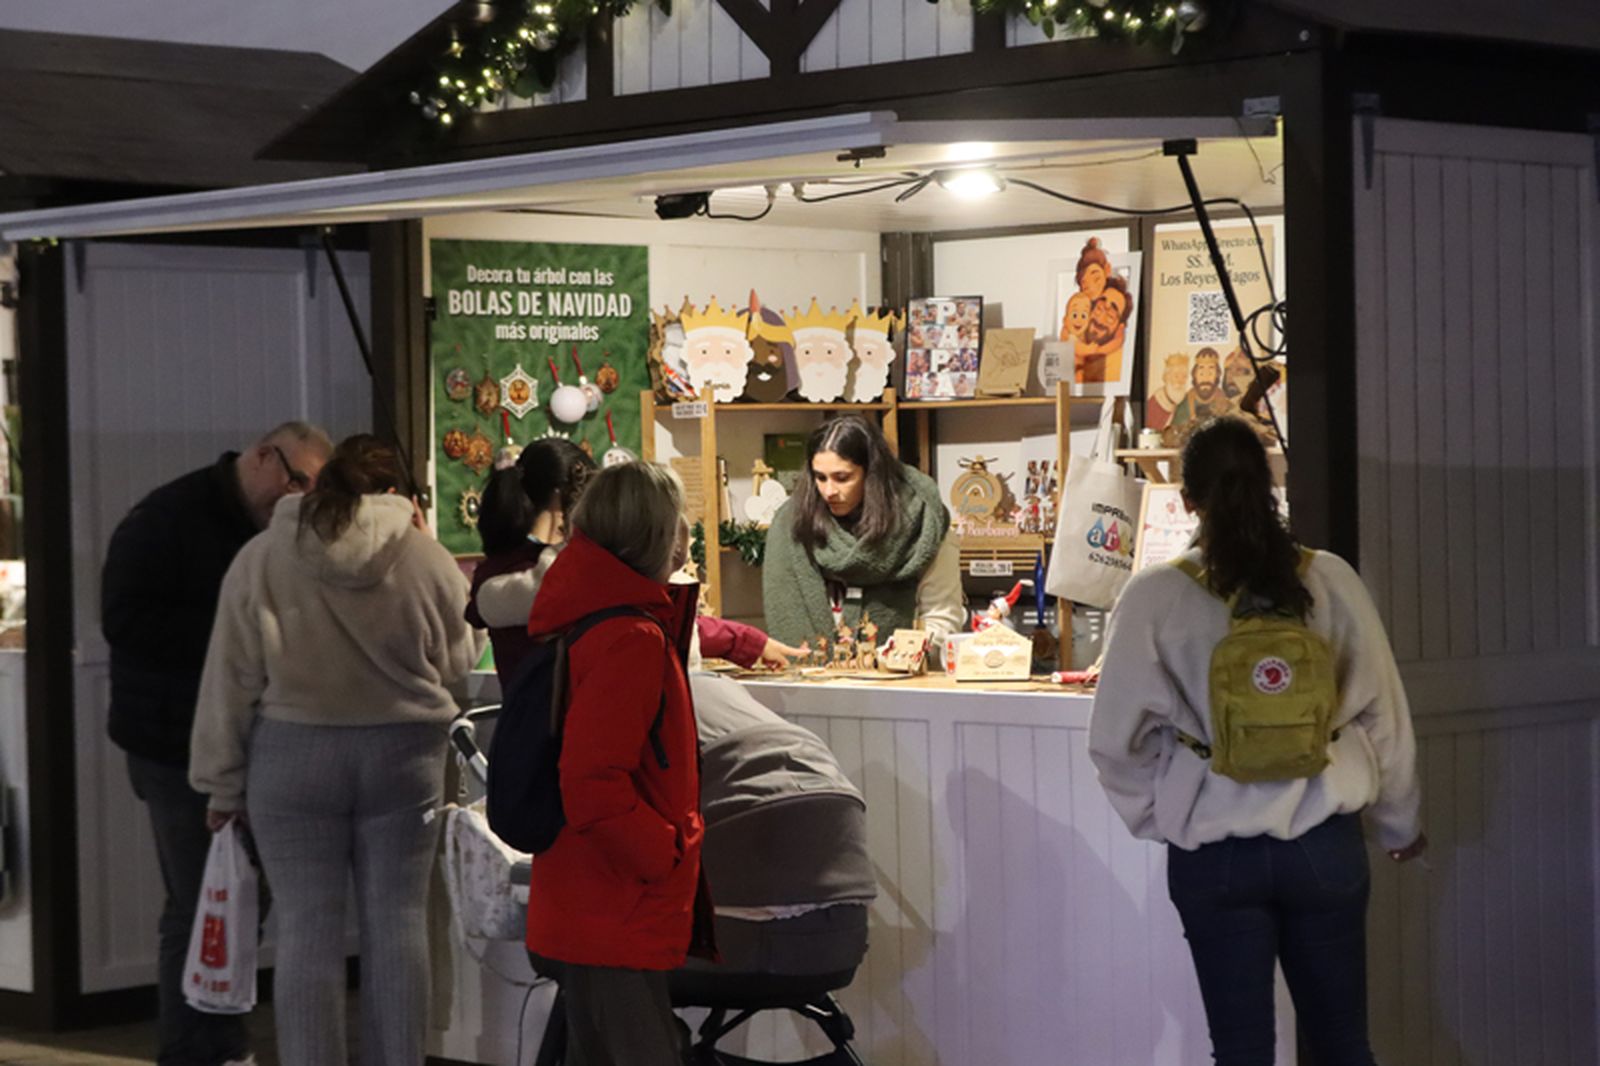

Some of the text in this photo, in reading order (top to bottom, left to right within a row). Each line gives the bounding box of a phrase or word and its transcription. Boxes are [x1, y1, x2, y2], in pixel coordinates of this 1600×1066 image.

[467, 265, 614, 286] Decora tu árbol con las
[1160, 270, 1260, 287] Los Reyes agos
[448, 289, 632, 317] BOLAS DE NAVIDAD
[495, 321, 599, 344] más originales
